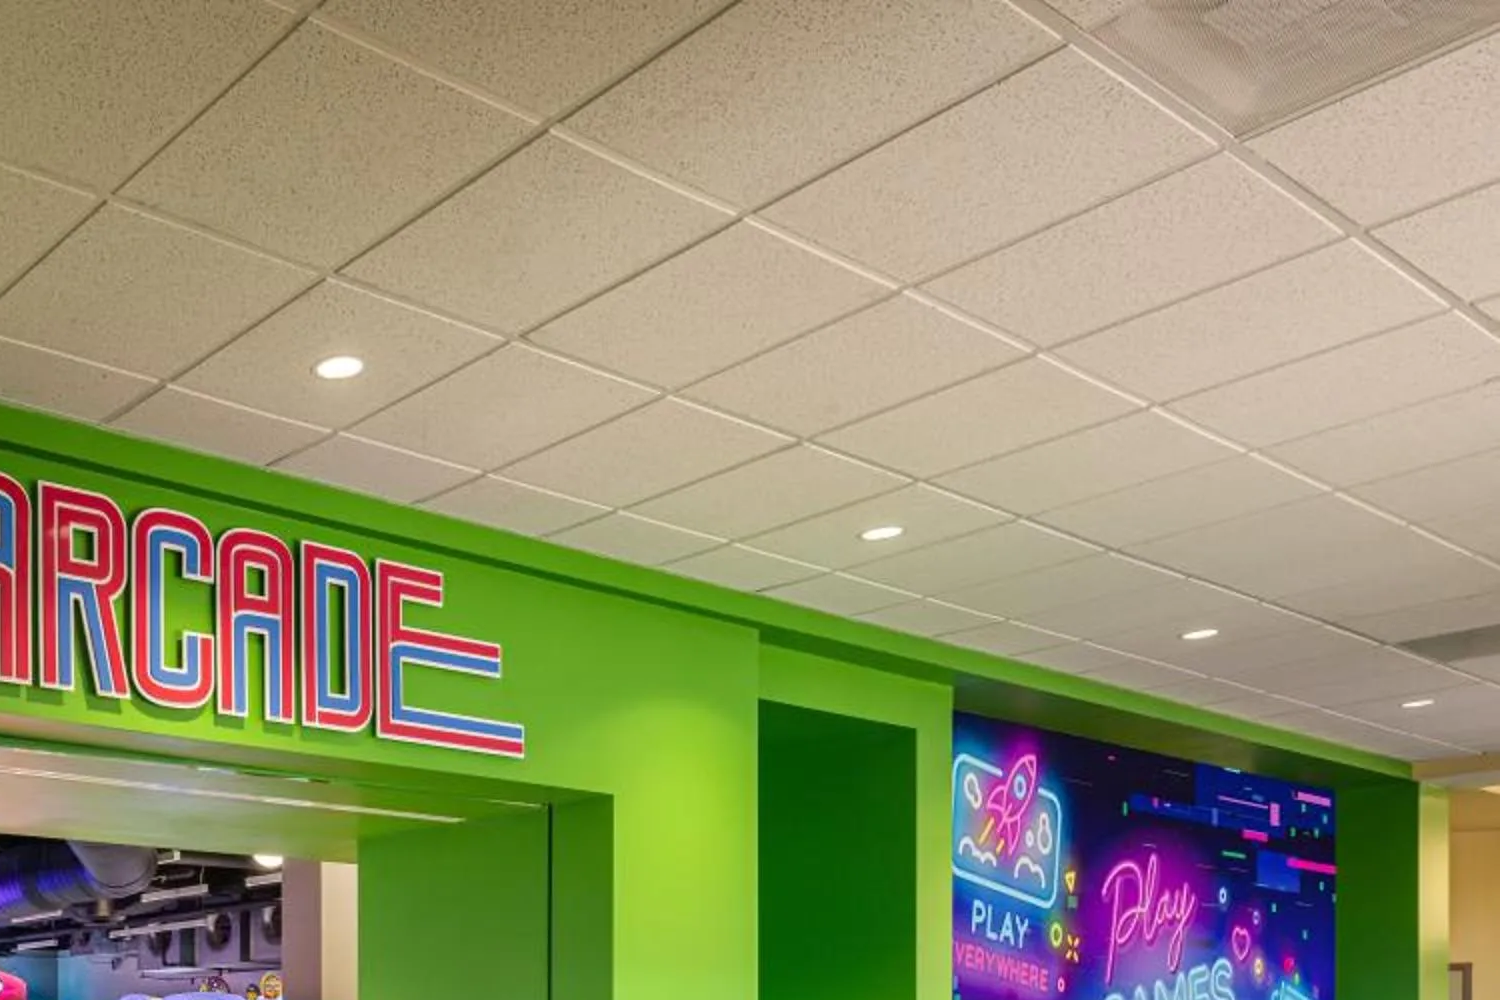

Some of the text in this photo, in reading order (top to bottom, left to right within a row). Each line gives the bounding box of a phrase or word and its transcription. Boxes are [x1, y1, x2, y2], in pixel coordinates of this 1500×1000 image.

[970, 899, 1030, 949] PLAY
[1101, 853, 1198, 984] Play
[954, 941, 1049, 992] VERYWHERE
